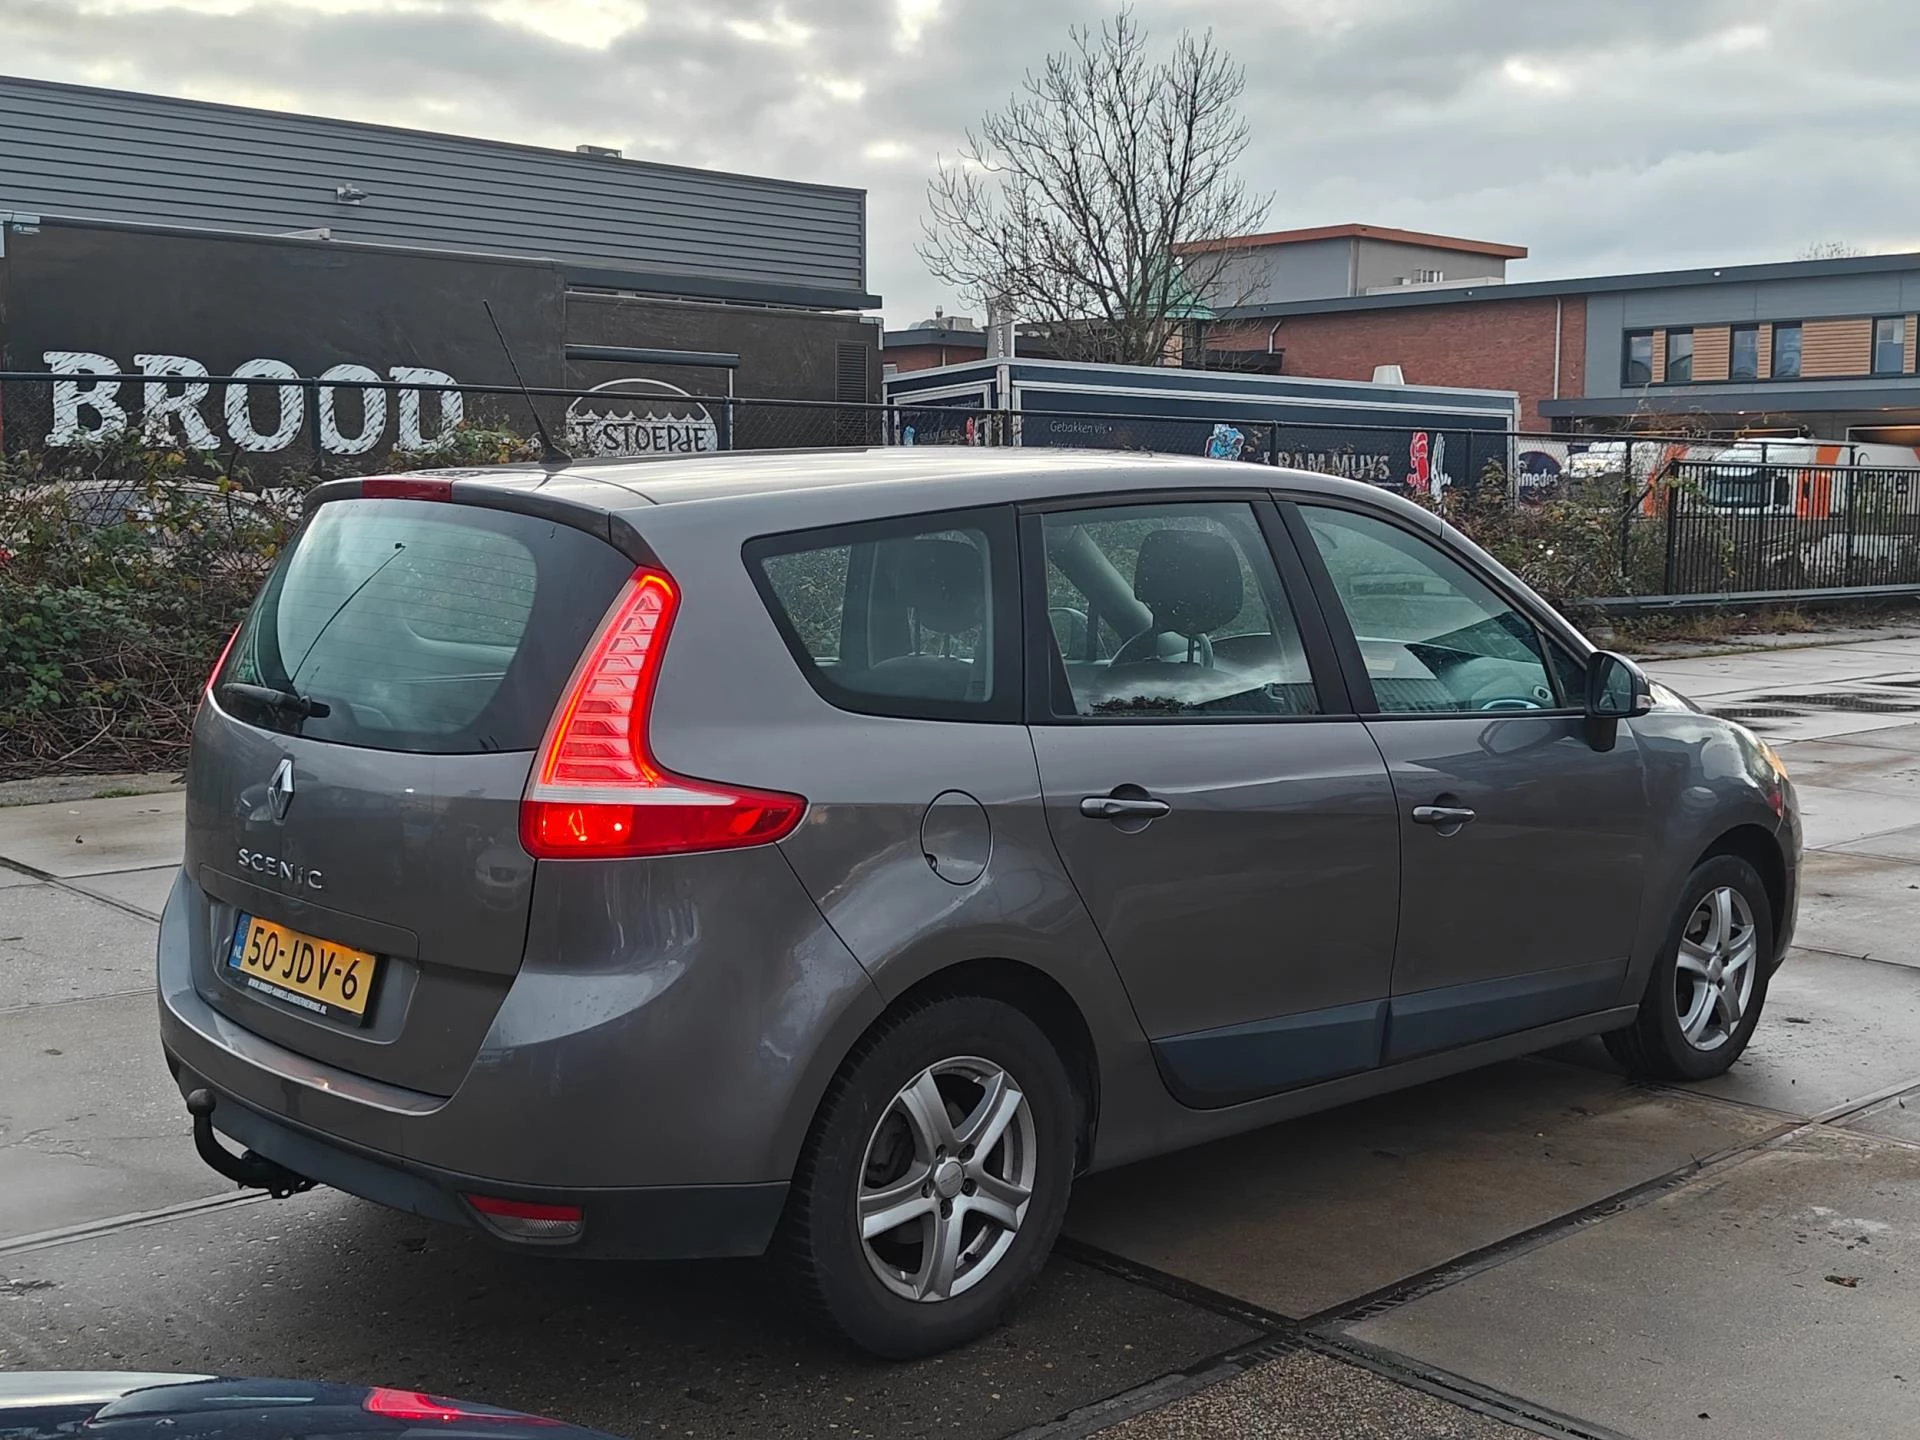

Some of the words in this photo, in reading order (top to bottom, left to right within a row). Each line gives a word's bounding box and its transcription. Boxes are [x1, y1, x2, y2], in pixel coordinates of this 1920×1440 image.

[43, 351, 464, 455] BROOD
[1050, 420, 1093, 434] Gebakken
[238, 848, 323, 889] SCENIC
[232, 944, 242, 959] NL
[248, 926, 361, 1000] 50-JDV-6
